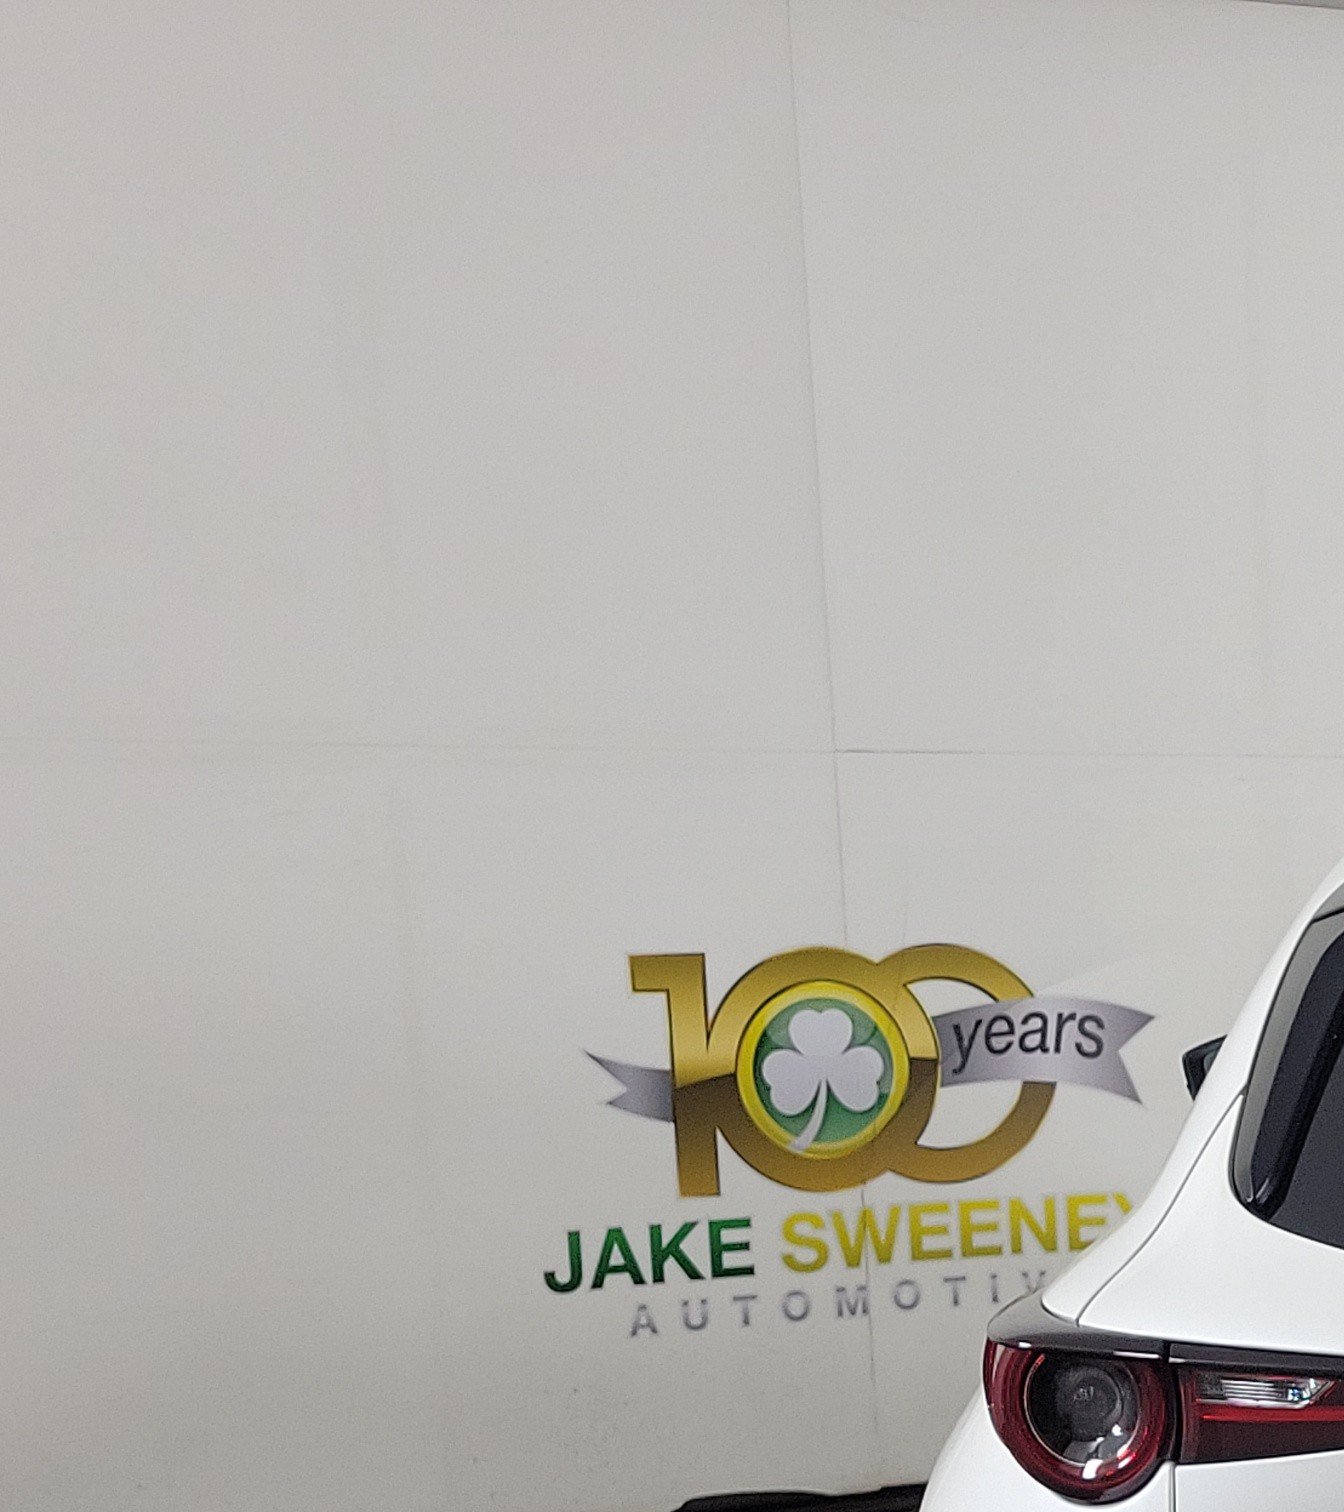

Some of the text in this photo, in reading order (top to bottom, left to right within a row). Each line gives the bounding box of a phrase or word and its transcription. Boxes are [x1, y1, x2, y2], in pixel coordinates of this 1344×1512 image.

[628, 943, 1056, 1197] 100
[951, 1006, 1107, 1074] years
[542, 1191, 1133, 1295] JAKE SWEENE
